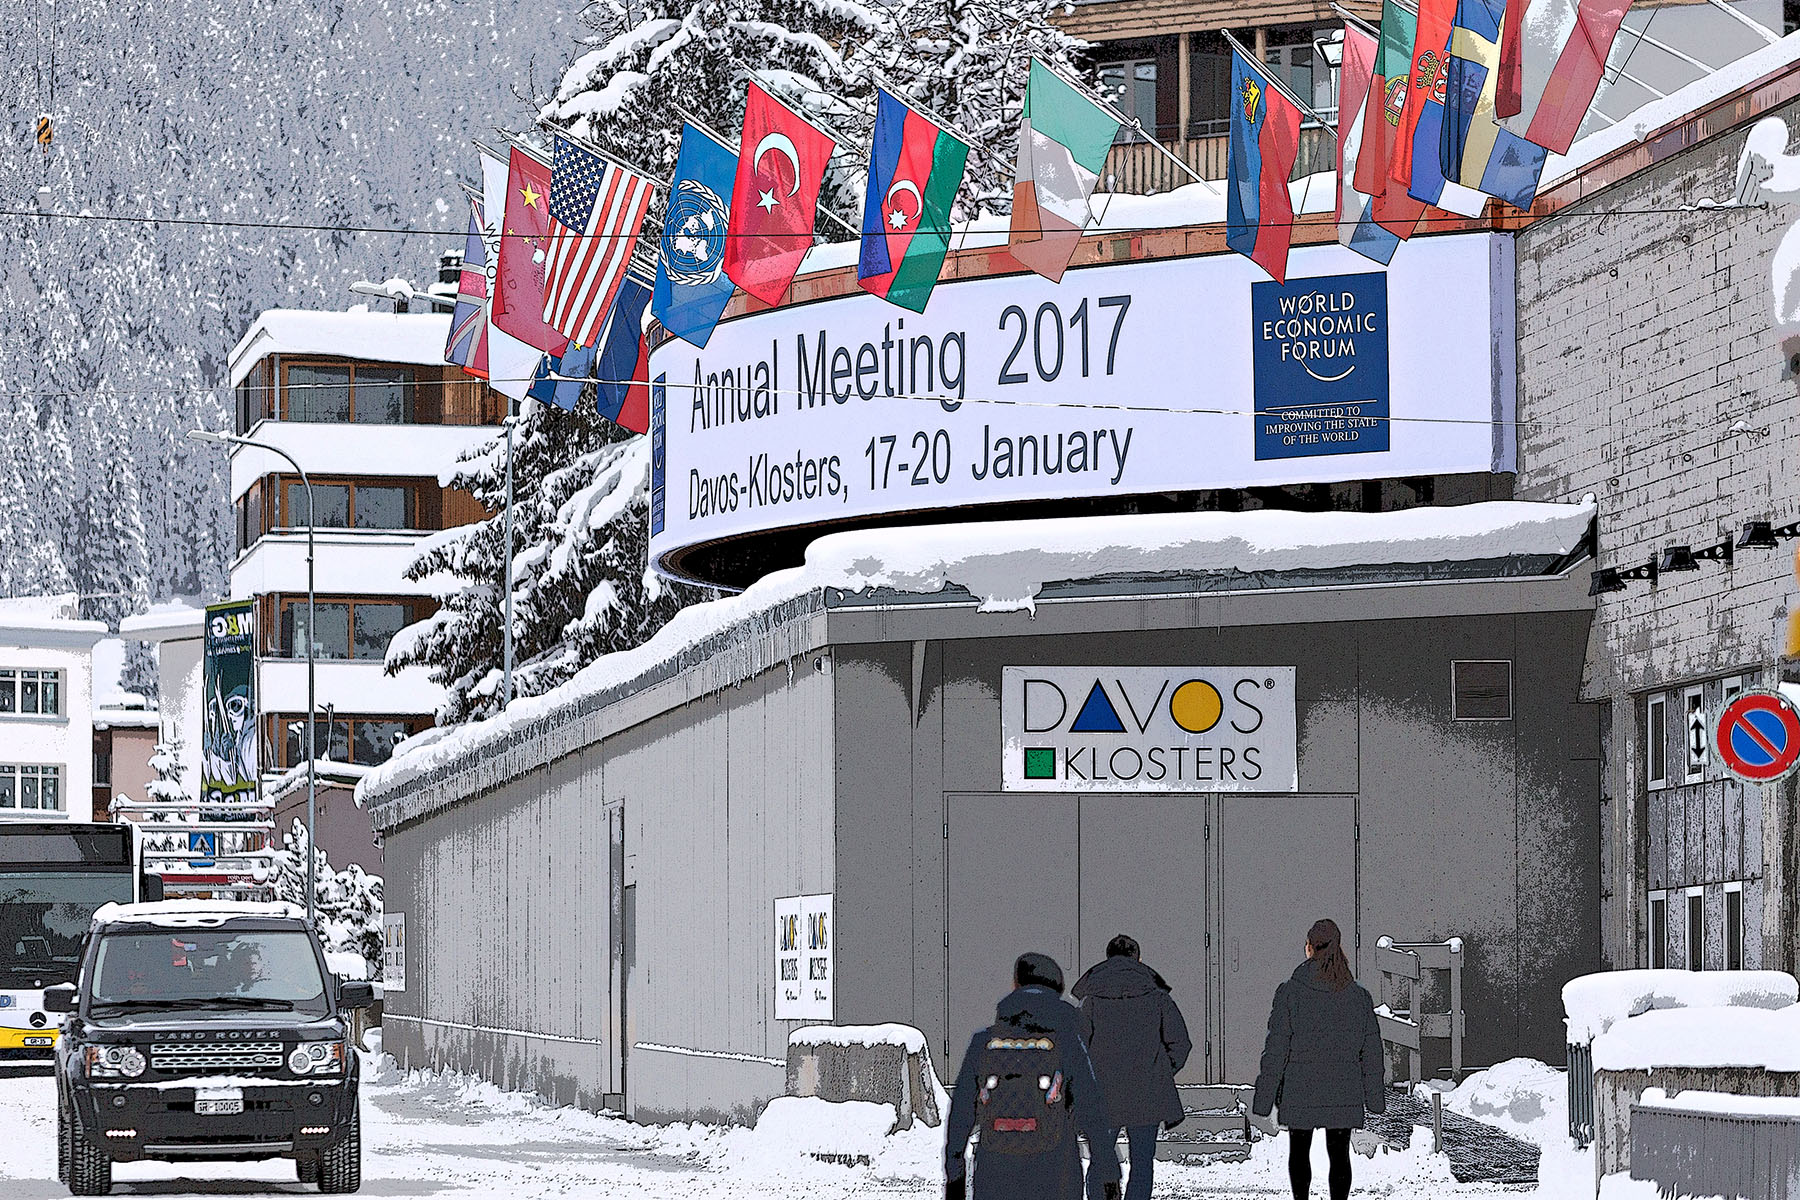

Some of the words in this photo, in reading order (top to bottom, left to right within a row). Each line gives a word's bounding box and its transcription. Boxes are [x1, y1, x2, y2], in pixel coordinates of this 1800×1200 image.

[1279, 291, 1355, 315] WORLD
[1263, 312, 1377, 340] ECONOMIC
[1281, 338, 1356, 361] FORUM
[690, 339, 779, 433] Annual
[796, 318, 966, 413] Meeting
[998, 294, 1132, 386] 2017
[1281, 407, 1344, 421] COMMITTED
[1346, 405, 1361, 417] TO
[1265, 421, 1322, 435] IMPROVING
[1324, 419, 1346, 430] THE
[1347, 416, 1378, 429] STATE
[1283, 435, 1297, 446] OF
[1299, 433, 1320, 444] THE
[1321, 431, 1359, 443] WORLD
[689, 449, 848, 521] Davos-Klosters,
[865, 428, 951, 491] 17-20
[971, 424, 1133, 486] January
[1064, 746, 1263, 782] KLOSTERS
[154, 1031, 206, 1040] LAND
[215, 1030, 281, 1040] ROVER
